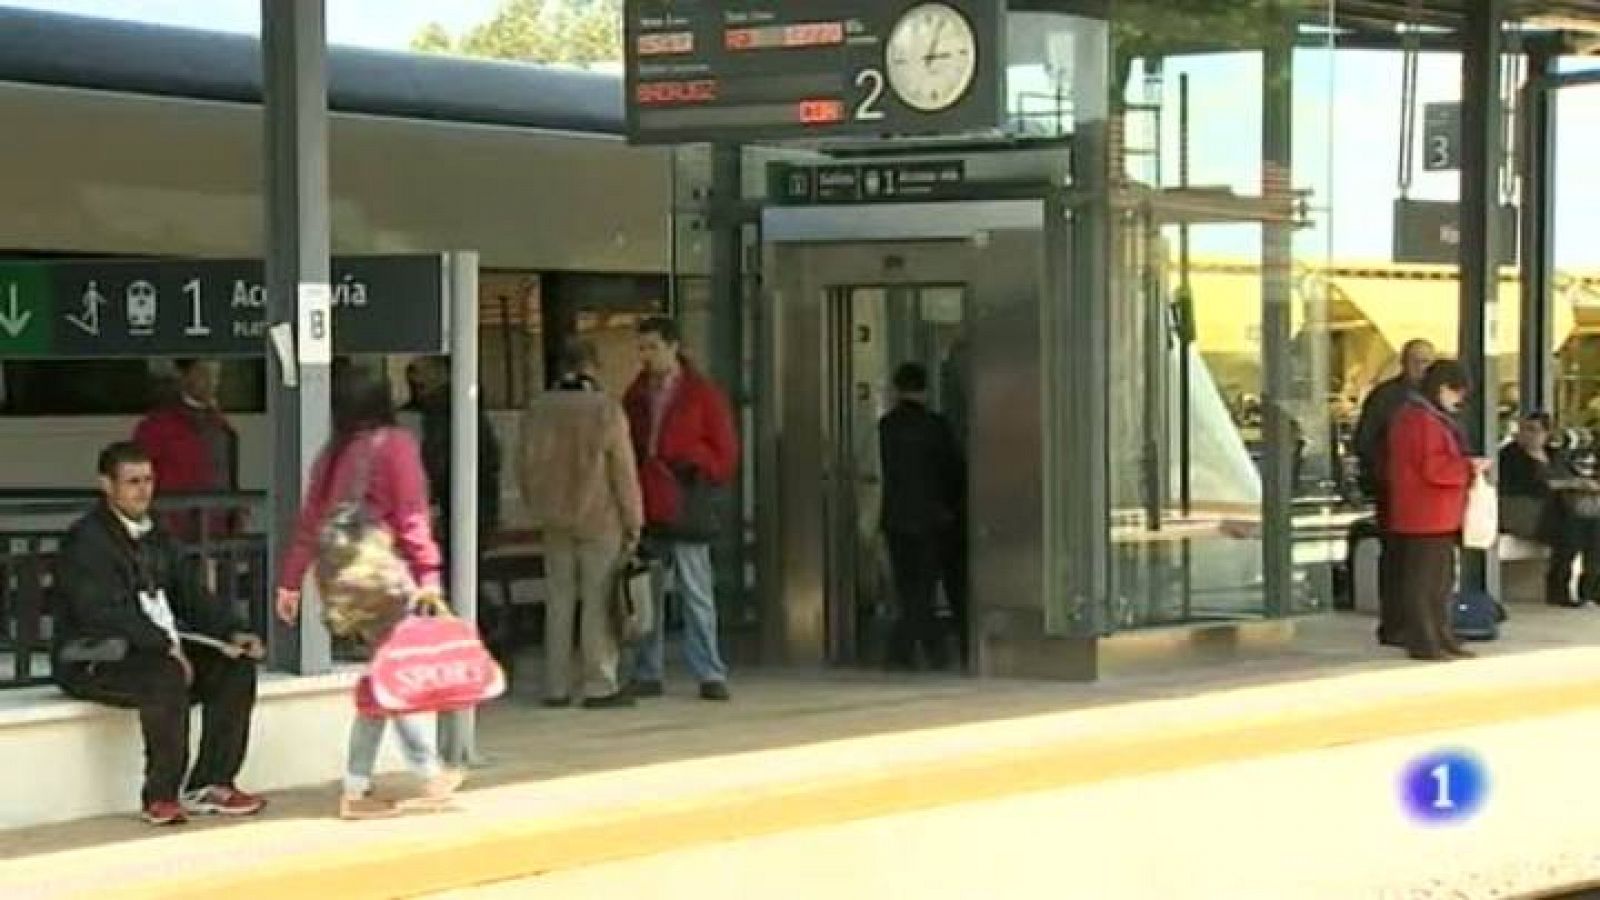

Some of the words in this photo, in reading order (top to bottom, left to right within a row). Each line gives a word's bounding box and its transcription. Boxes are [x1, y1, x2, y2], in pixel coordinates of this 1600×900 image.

[855, 69, 885, 120] 2
[1430, 135, 1450, 167] 3
[182, 279, 211, 336] 1
[310, 309, 324, 340] B
